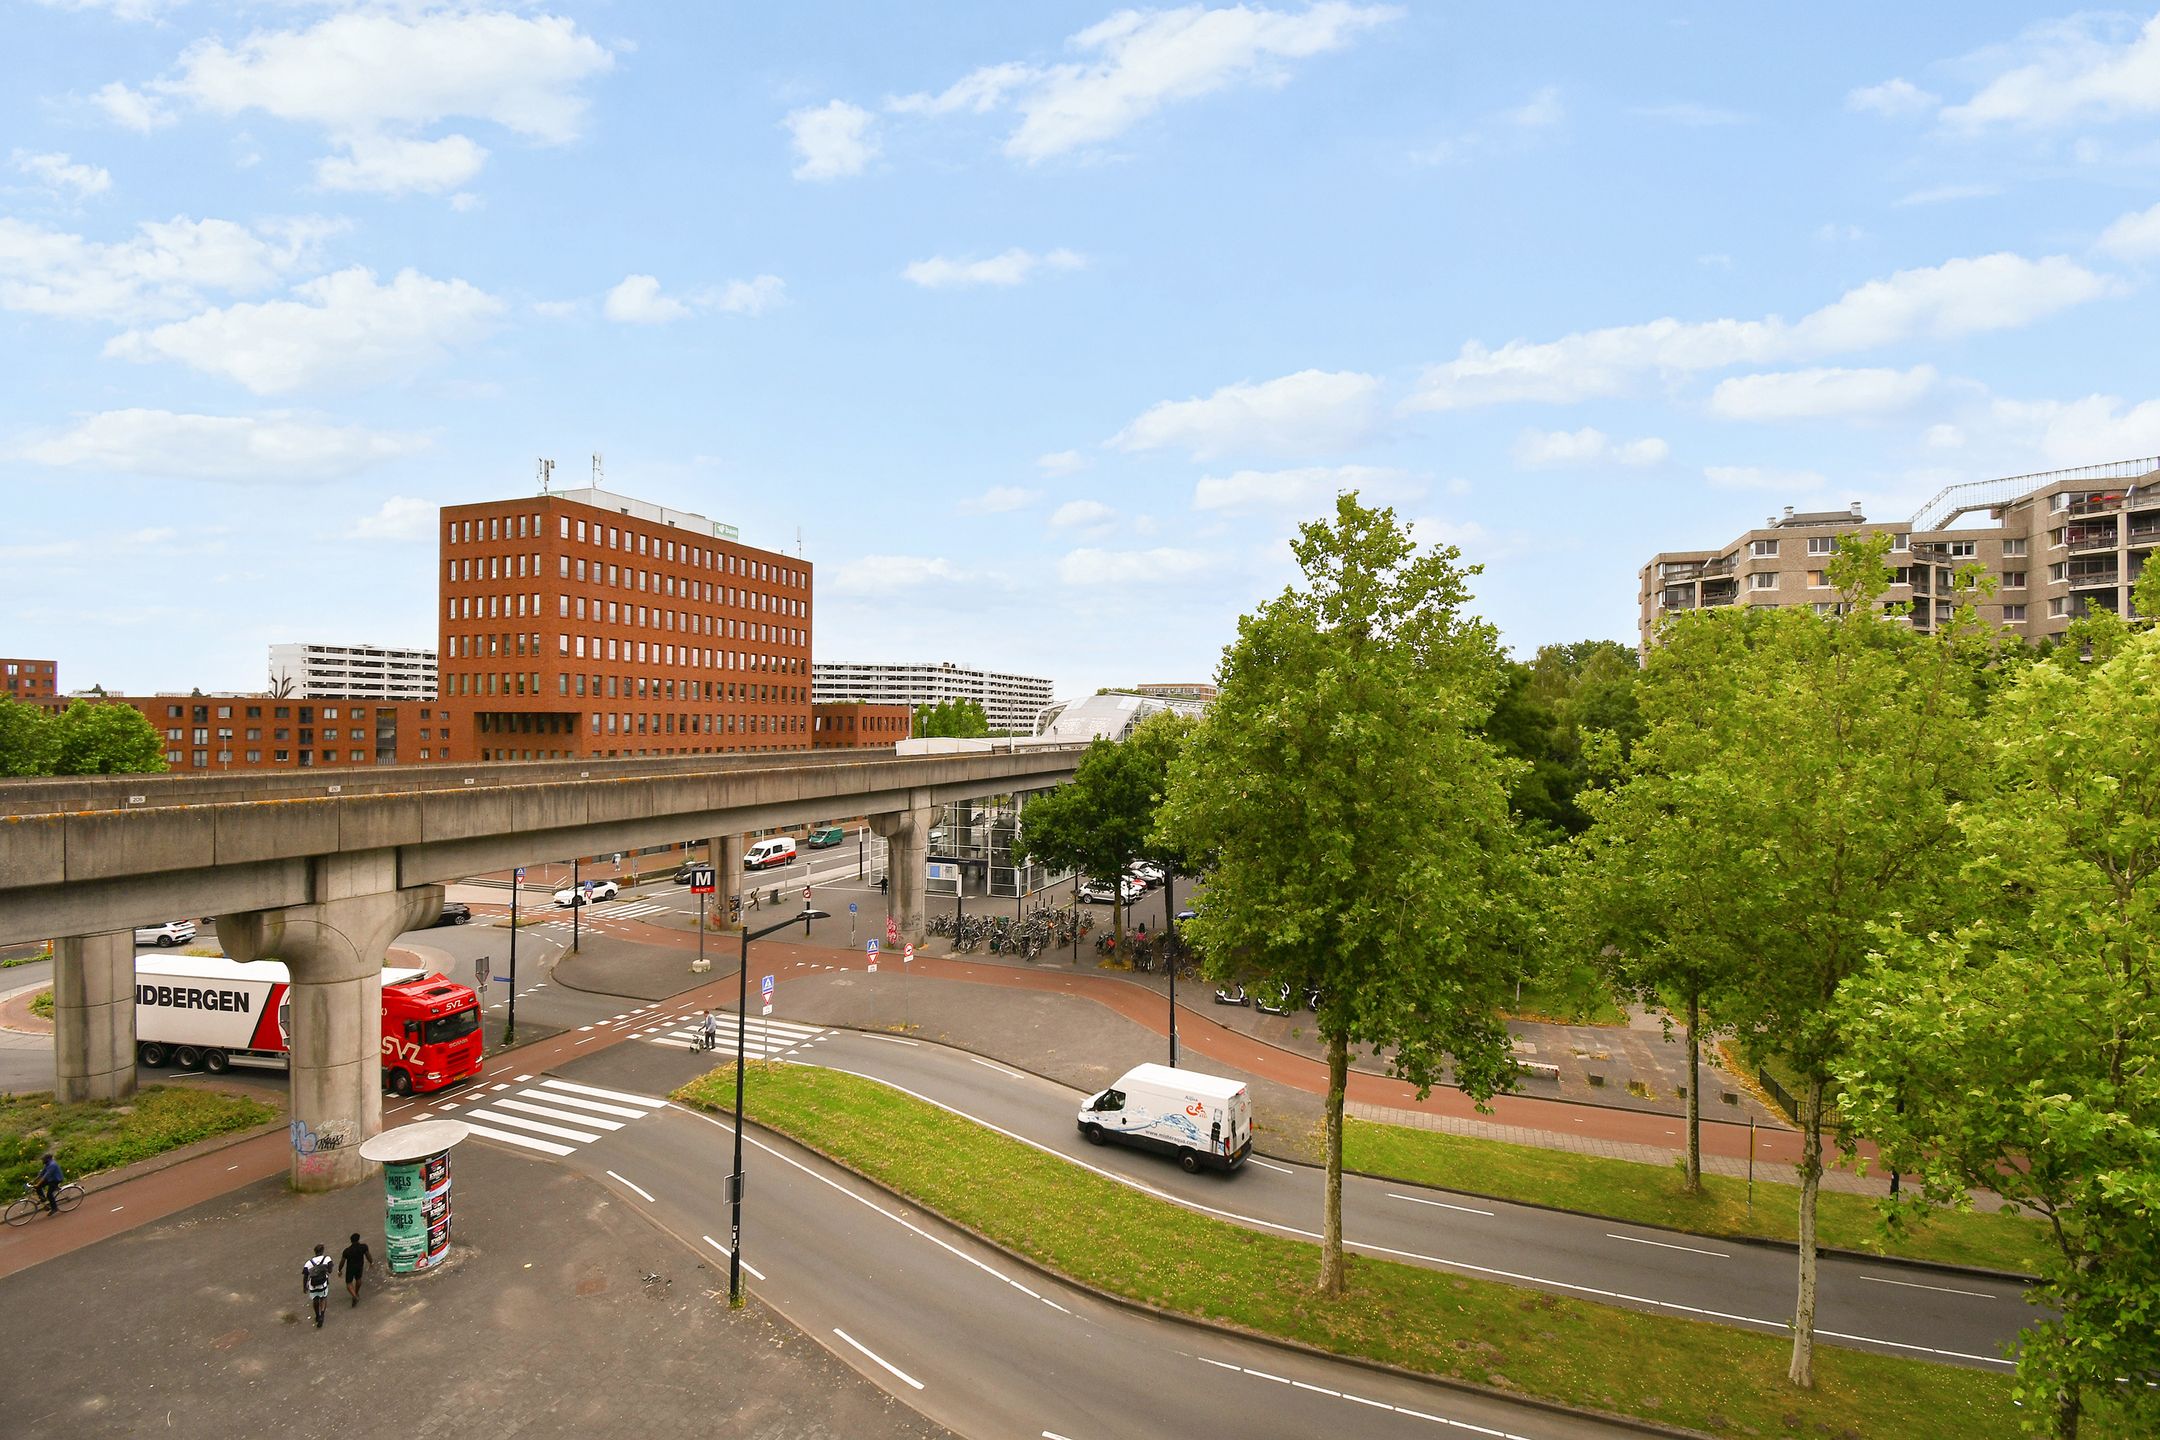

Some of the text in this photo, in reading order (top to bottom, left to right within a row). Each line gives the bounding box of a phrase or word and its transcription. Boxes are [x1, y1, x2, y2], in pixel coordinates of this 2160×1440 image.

[695, 871, 711, 886] M
[445, 1000, 464, 1011] SVZ
[381, 1035, 424, 1066] SVZ
